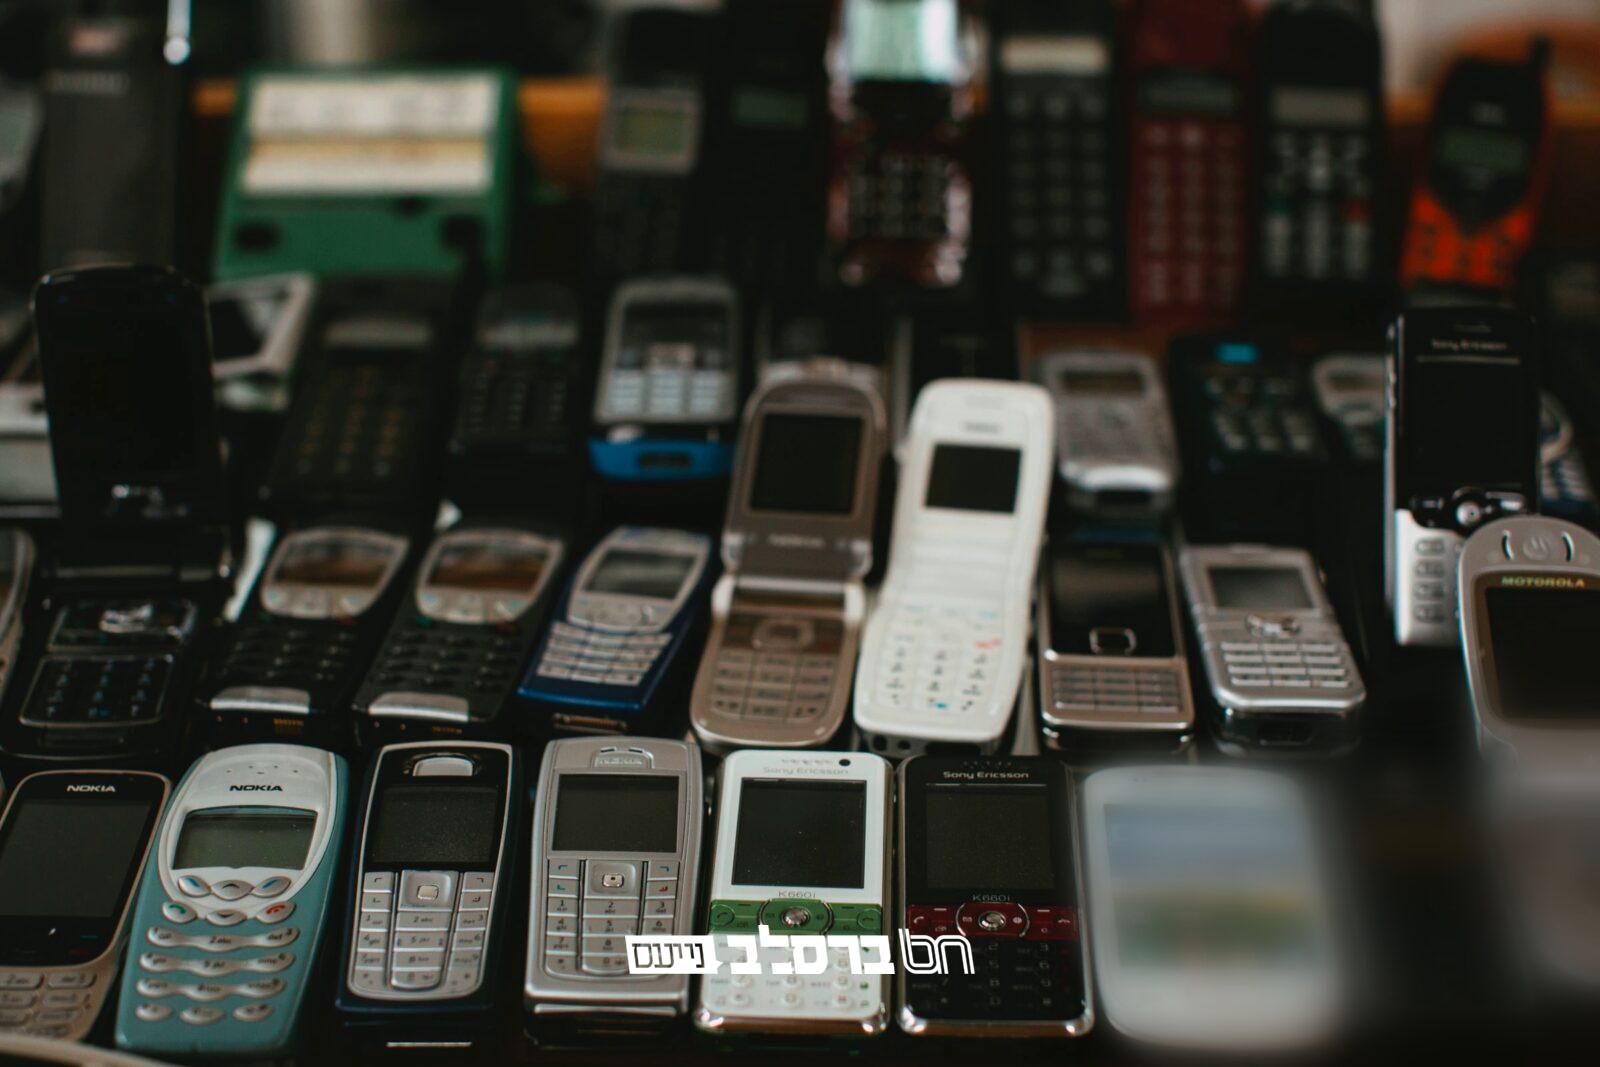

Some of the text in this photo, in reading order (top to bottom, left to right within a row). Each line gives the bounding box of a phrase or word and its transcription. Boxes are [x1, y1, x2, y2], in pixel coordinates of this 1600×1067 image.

[1501, 576, 1585, 588] MOTOROLA
[763, 766, 849, 775] Sony Ericsson
[943, 771, 1030, 780] Sony Ericsson
[66, 784, 116, 793] NOKIA
[229, 784, 283, 792] NOKIA
[778, 890, 816, 898] K660i
[972, 894, 1011, 902] K660i
